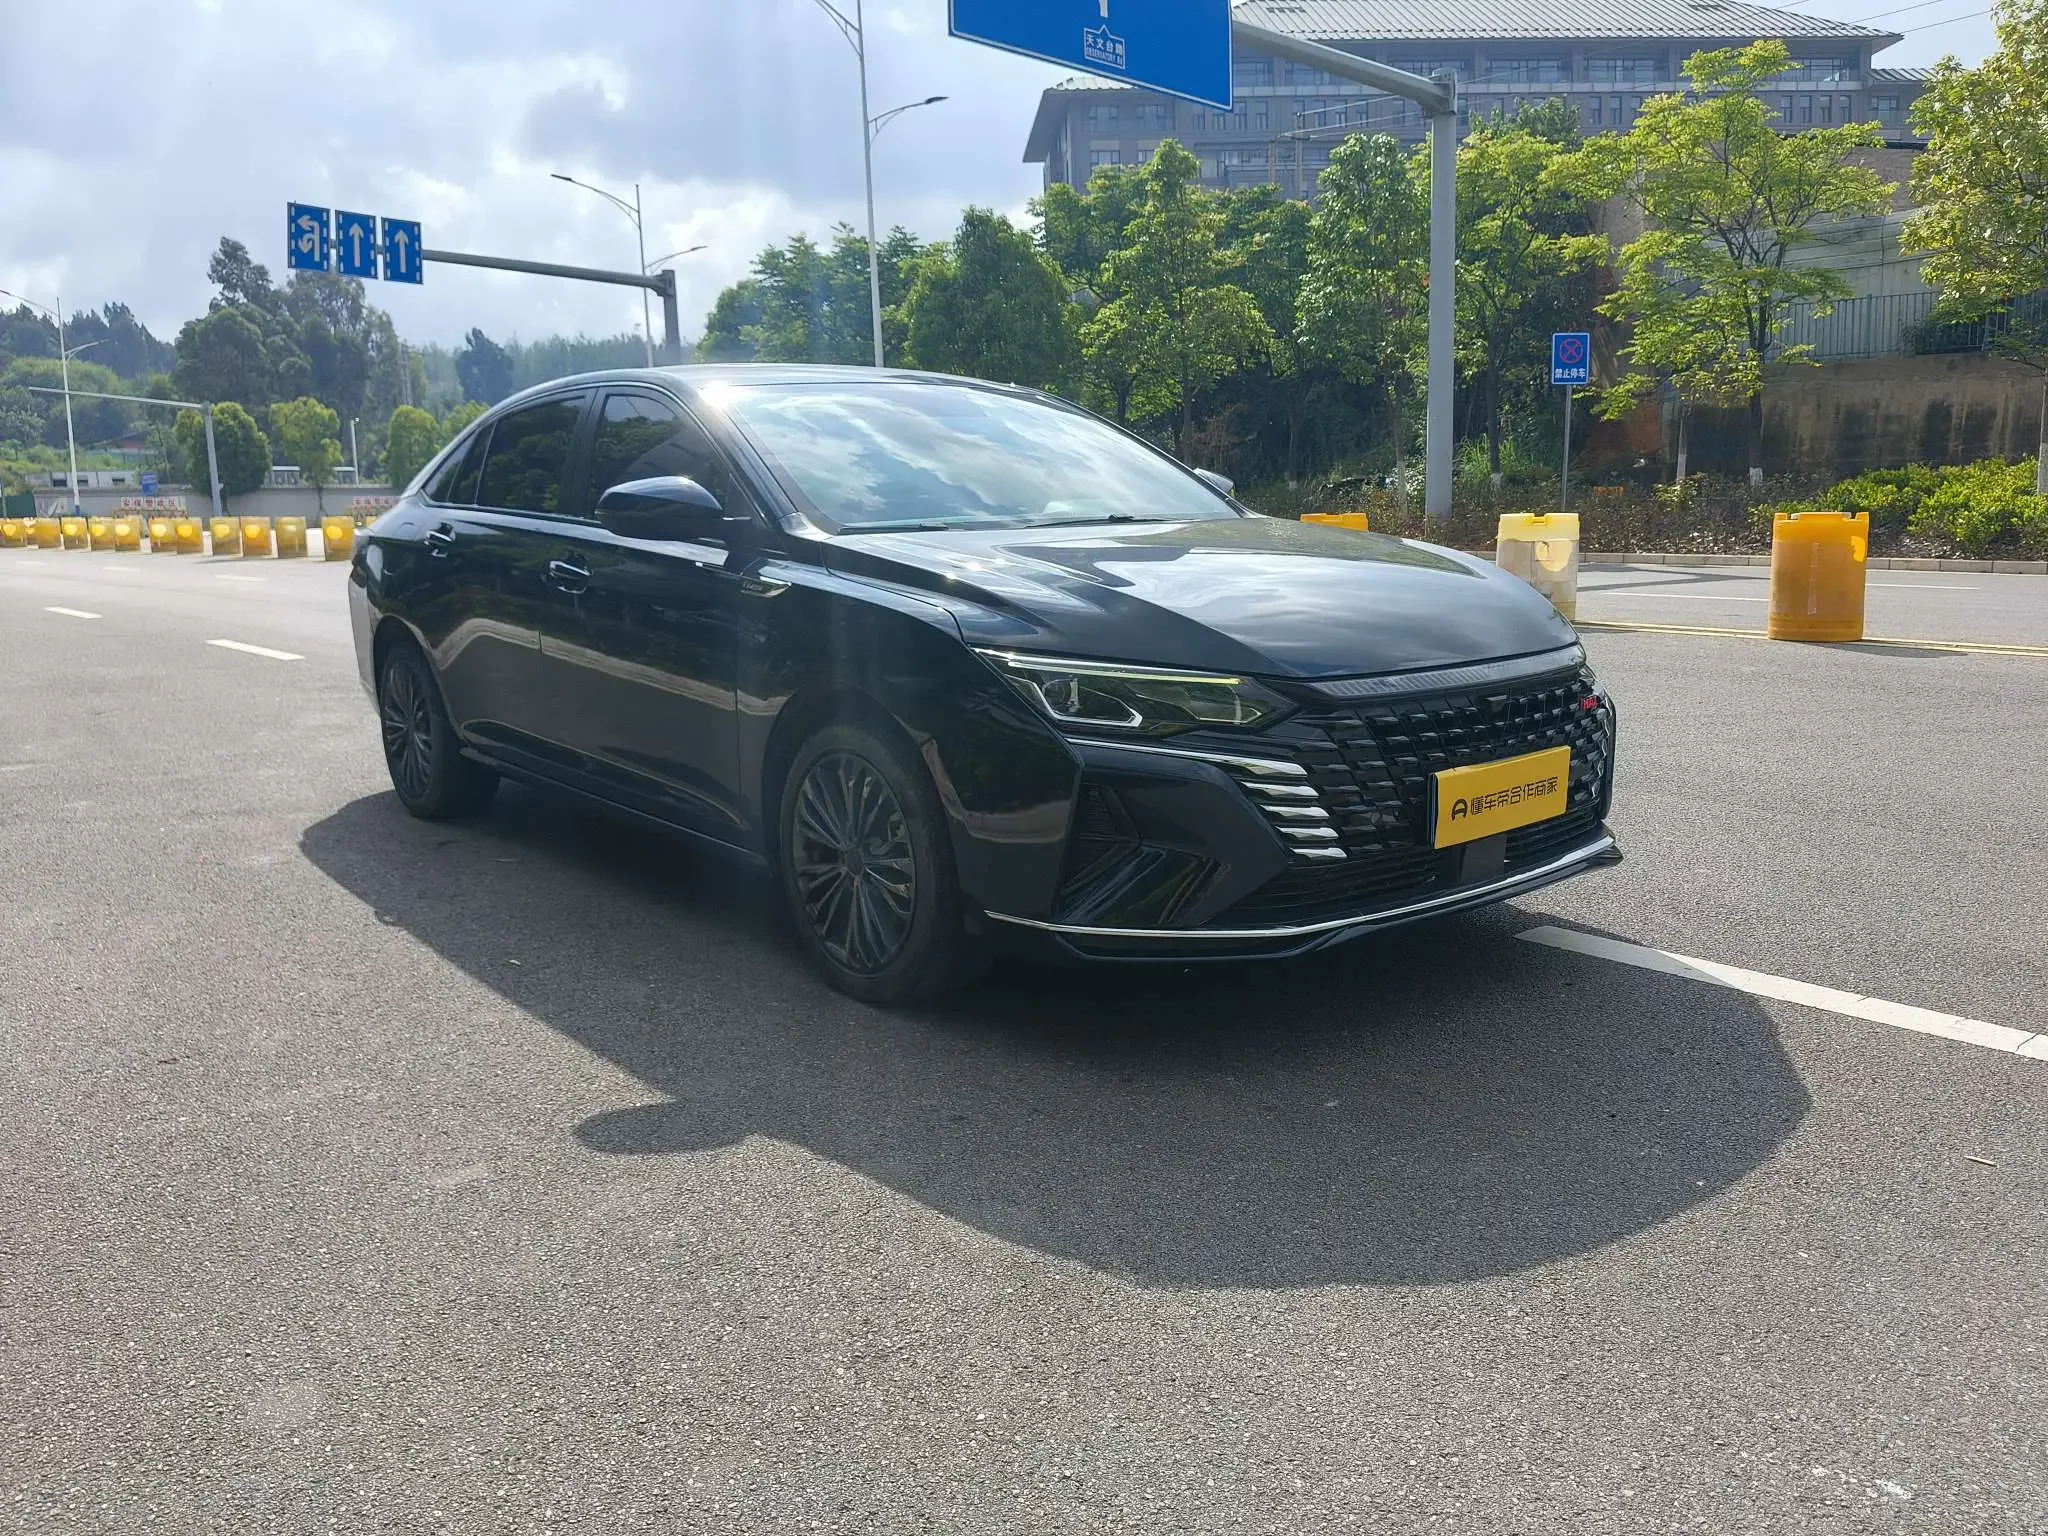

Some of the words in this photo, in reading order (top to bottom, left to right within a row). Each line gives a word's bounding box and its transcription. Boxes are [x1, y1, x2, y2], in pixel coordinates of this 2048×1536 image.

[1555, 368, 1586, 378] 禁止停车
[1471, 776, 1559, 816] 懂车帝合作商家
